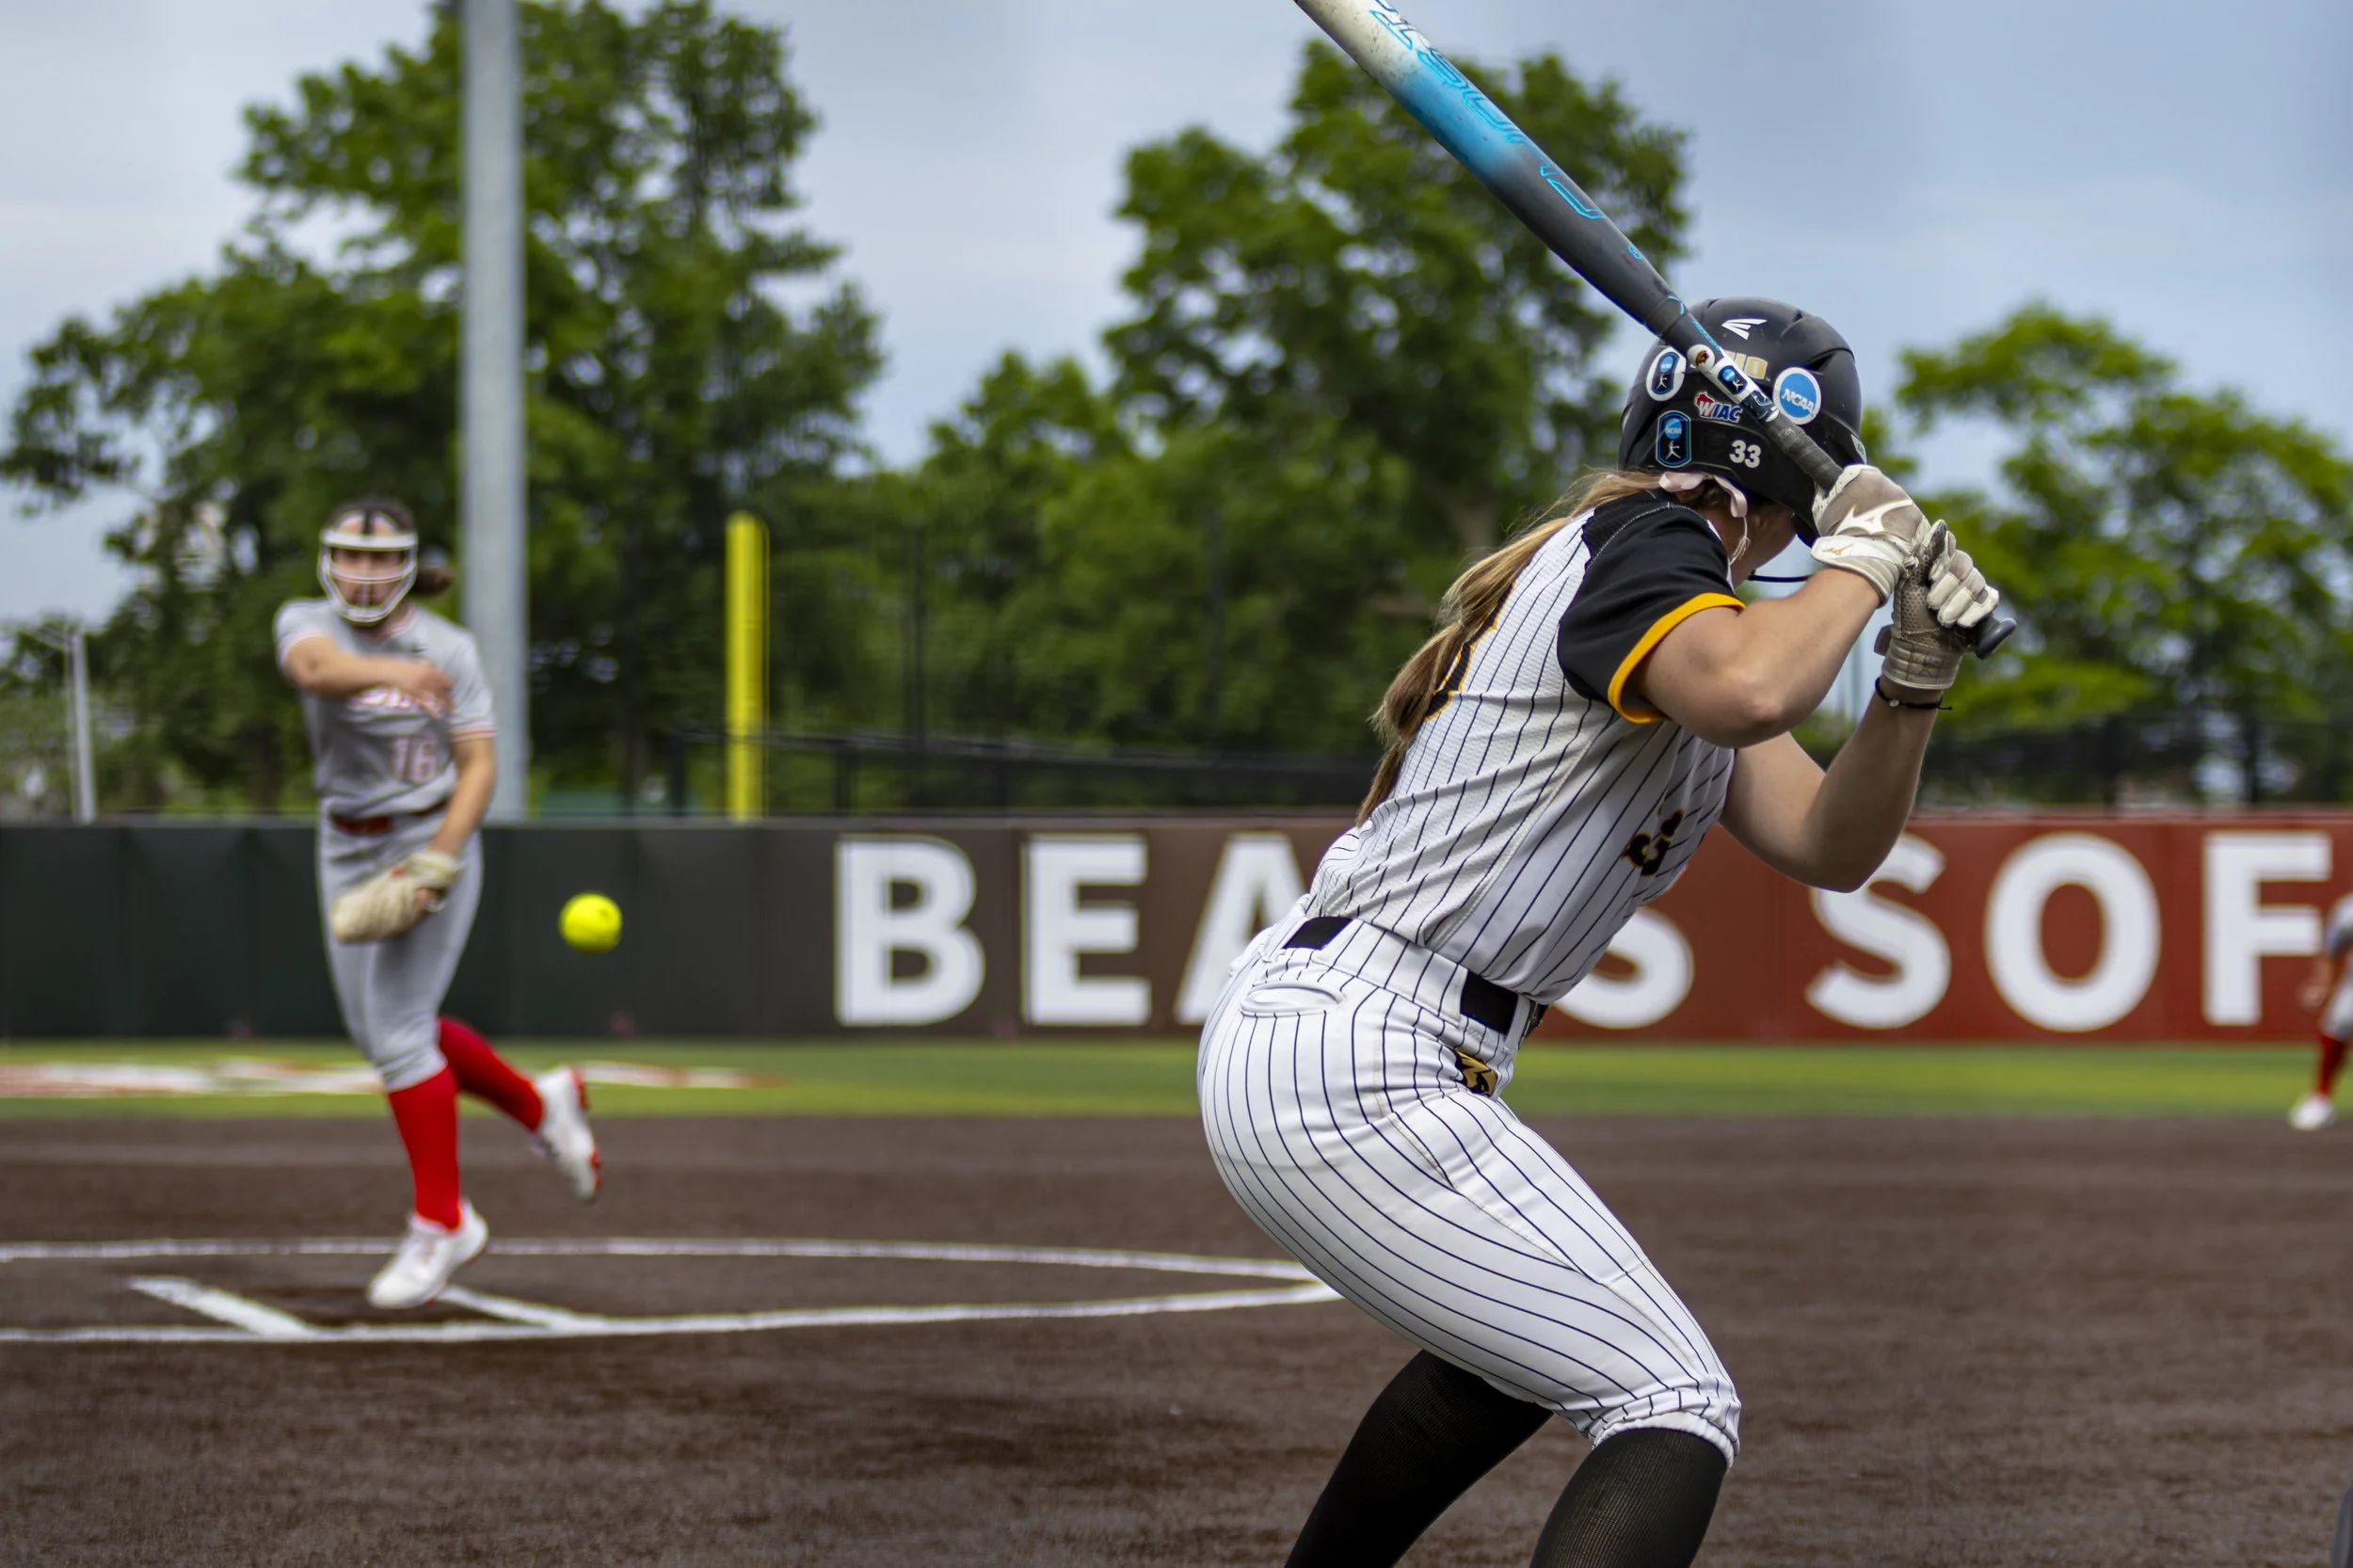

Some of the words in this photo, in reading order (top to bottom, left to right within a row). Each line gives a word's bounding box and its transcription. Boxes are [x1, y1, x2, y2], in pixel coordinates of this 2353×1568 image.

[1697, 400, 1742, 423] WIAC
[1782, 388, 1815, 414] NCAA
[1729, 440, 1762, 469] 33
